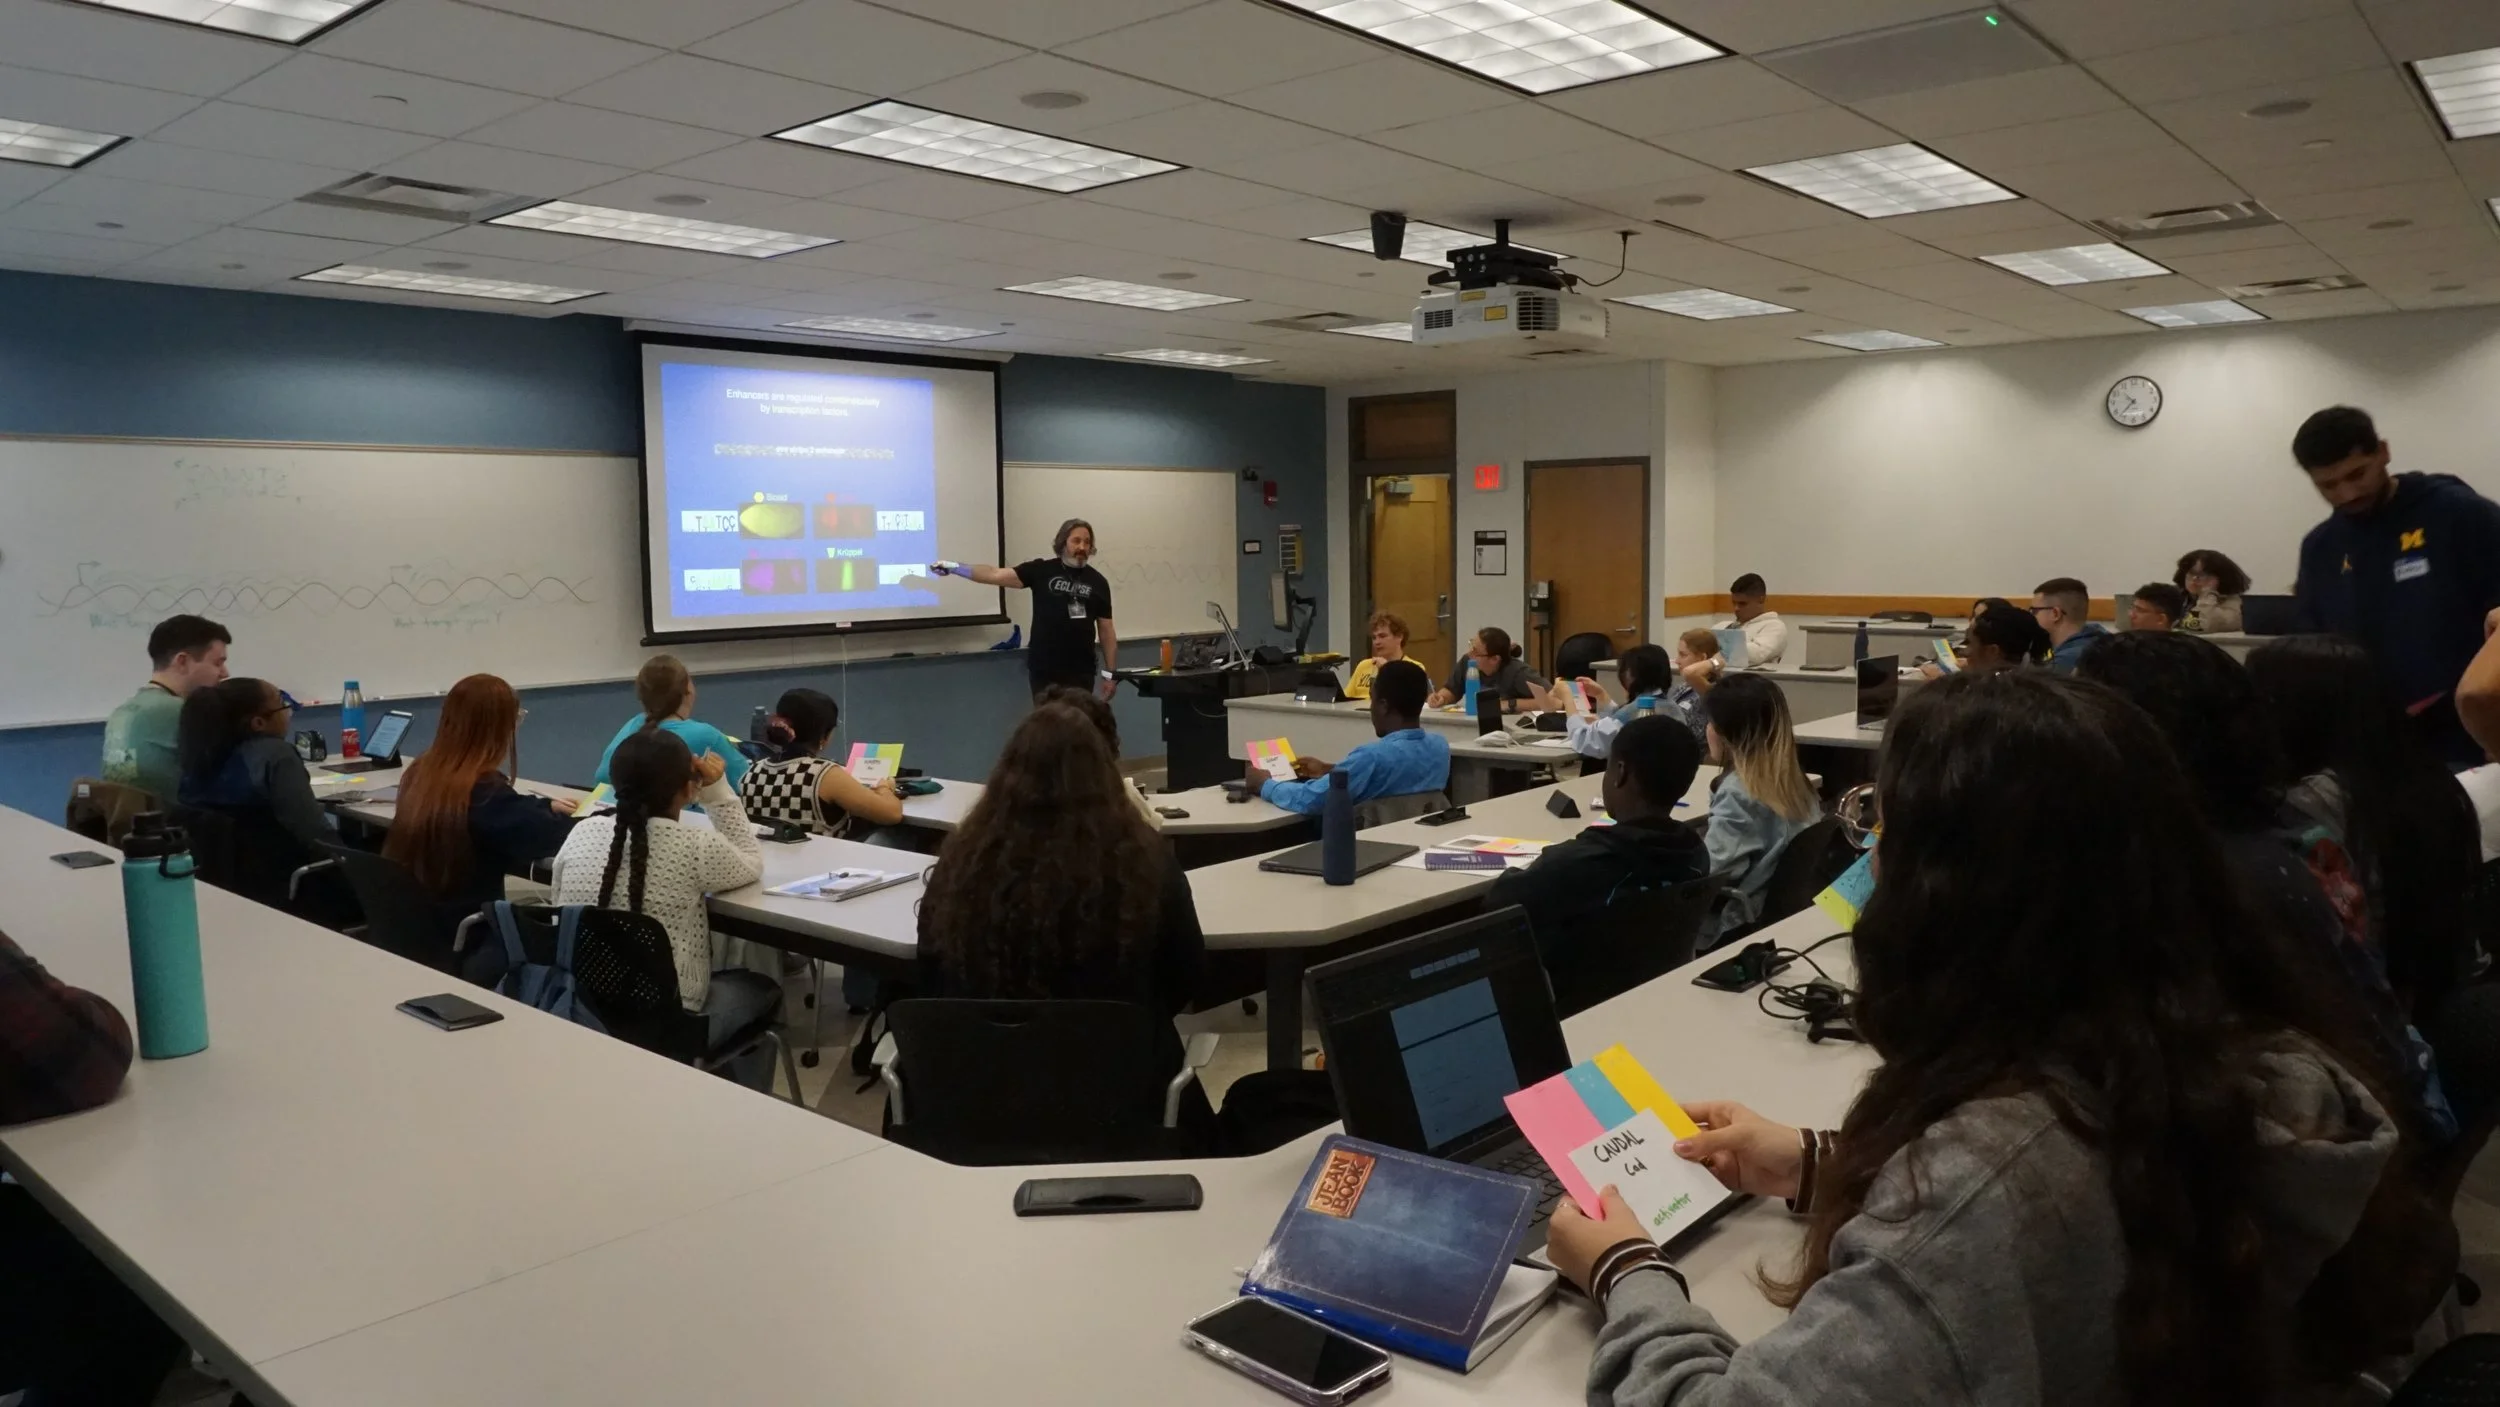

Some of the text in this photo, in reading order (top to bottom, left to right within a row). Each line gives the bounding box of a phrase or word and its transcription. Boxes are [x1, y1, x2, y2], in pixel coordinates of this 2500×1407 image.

[726, 388, 770, 400] Enhancers
[771, 392, 785, 401] are
[760, 403, 770, 415] by
[1475, 465, 1500, 489] EXIT
[2400, 528, 2425, 551] M
[1054, 580, 1092, 595] ECLISE
[1594, 1130, 1645, 1162] CAUDAL
[1315, 1156, 1350, 1206] JEAN
[1331, 1161, 1364, 1208] BOOK
[1653, 1193, 1692, 1226] activator
